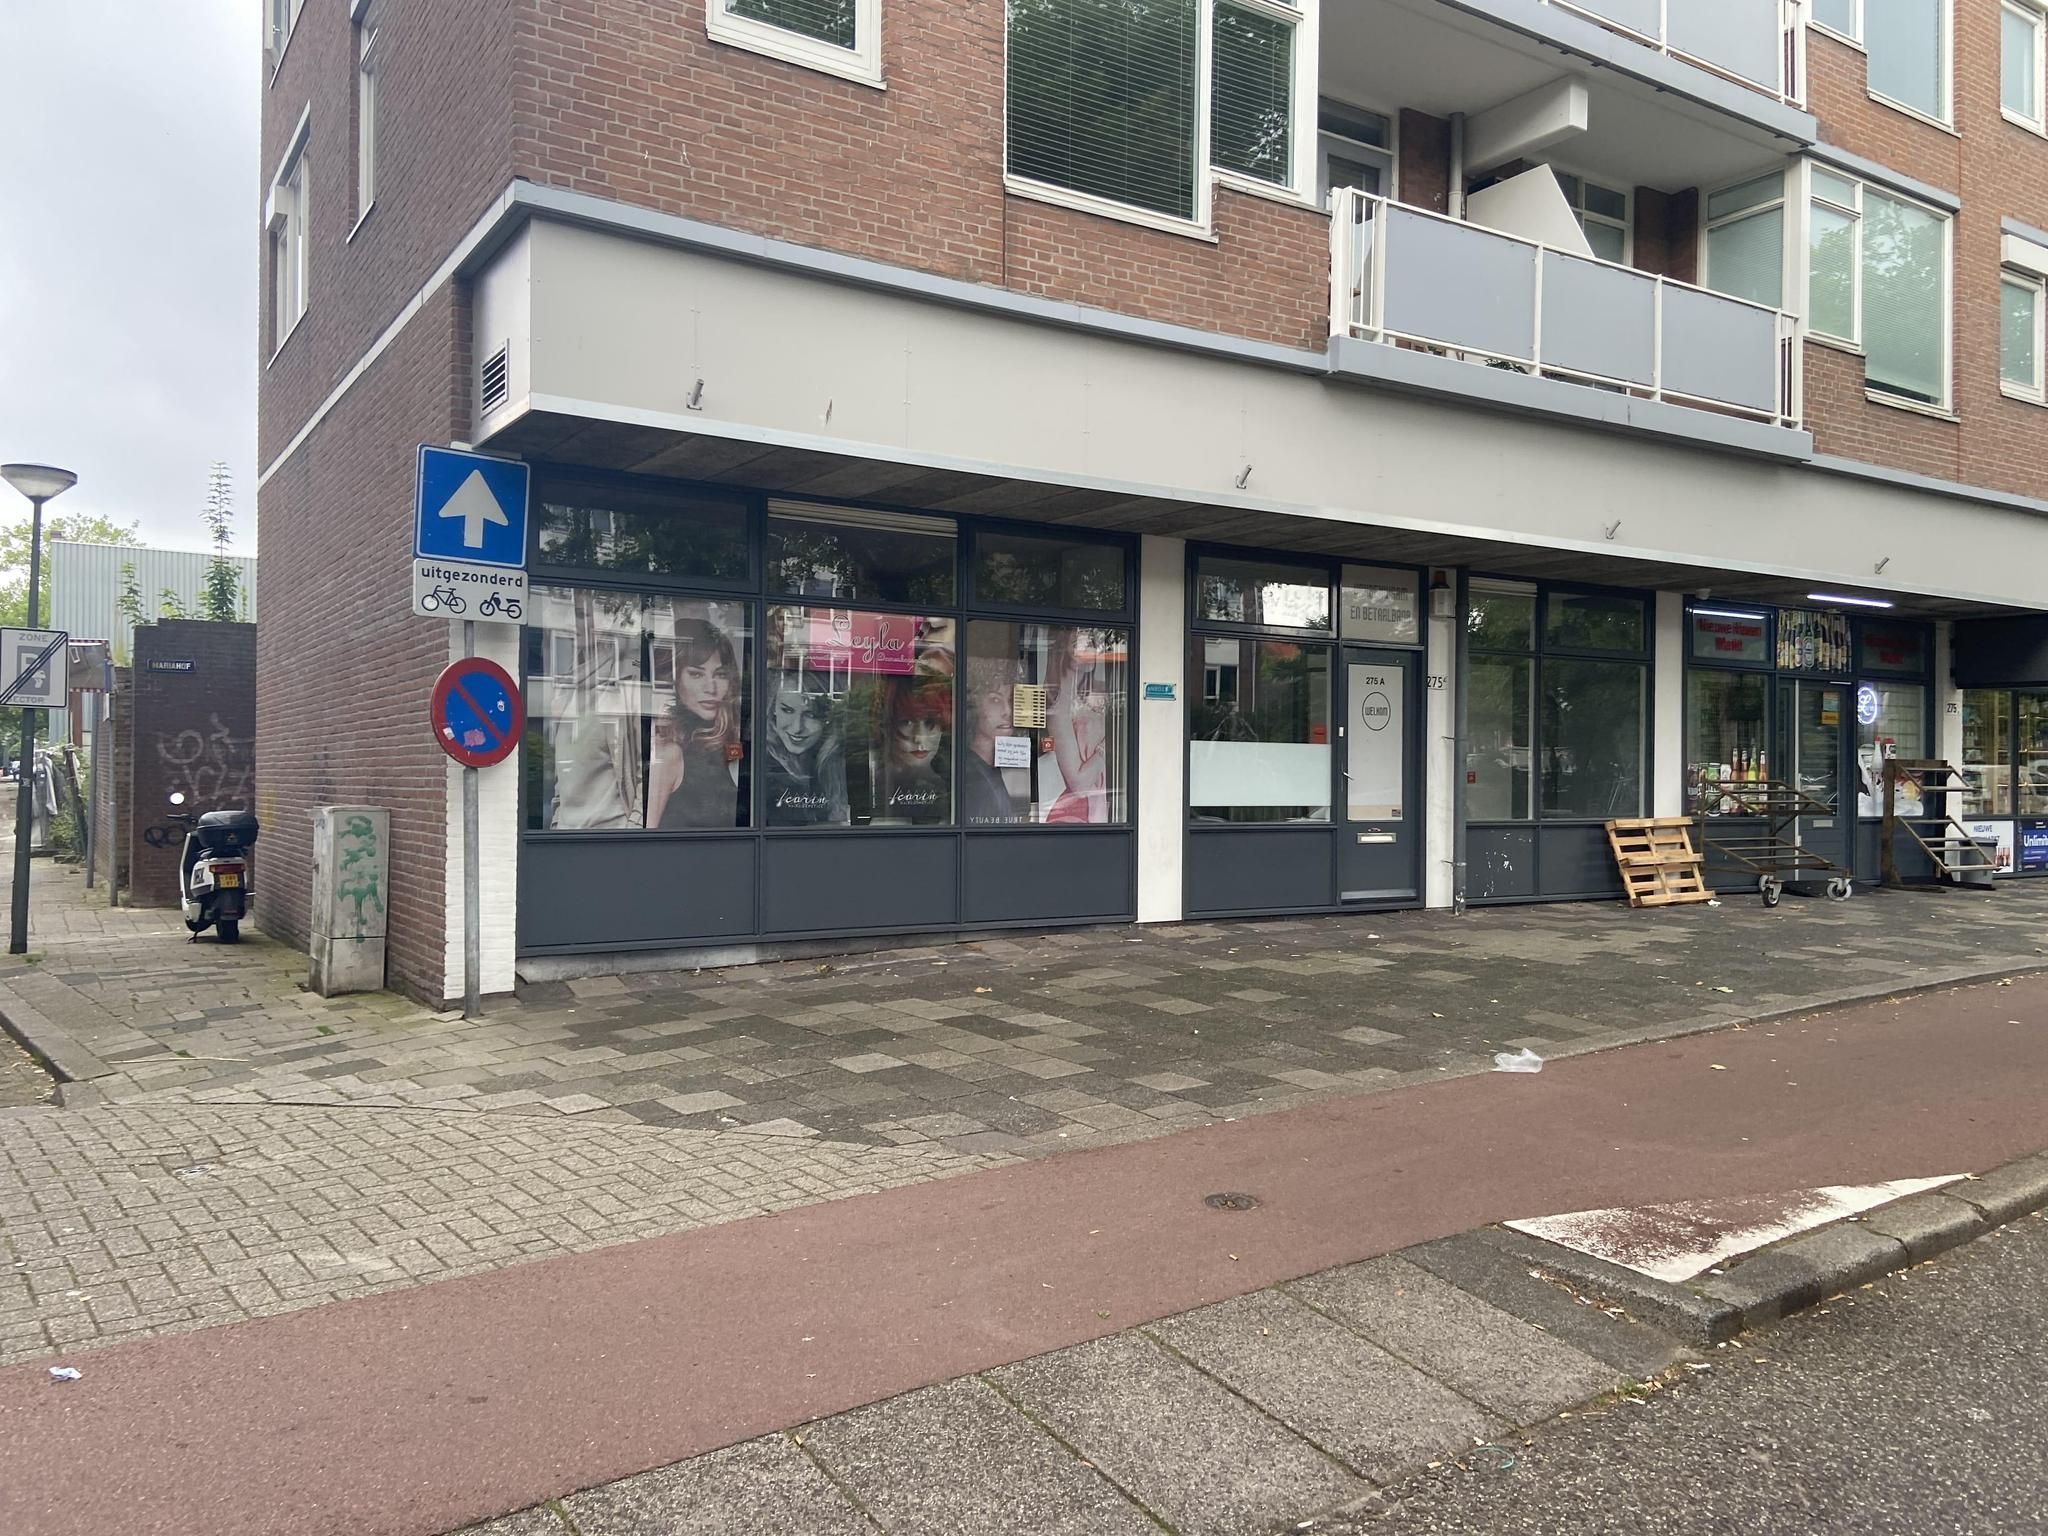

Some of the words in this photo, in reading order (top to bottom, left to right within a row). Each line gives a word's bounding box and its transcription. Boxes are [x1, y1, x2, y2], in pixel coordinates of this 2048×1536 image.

[421, 566, 523, 588] uitgezonderd
[18, 633, 49, 642] ZONE
[825, 614, 906, 664] Leyla
[152, 662, 192, 670] MARIAHOF
[1366, 677, 1379, 685] 275
[1379, 678, 1385, 686] A
